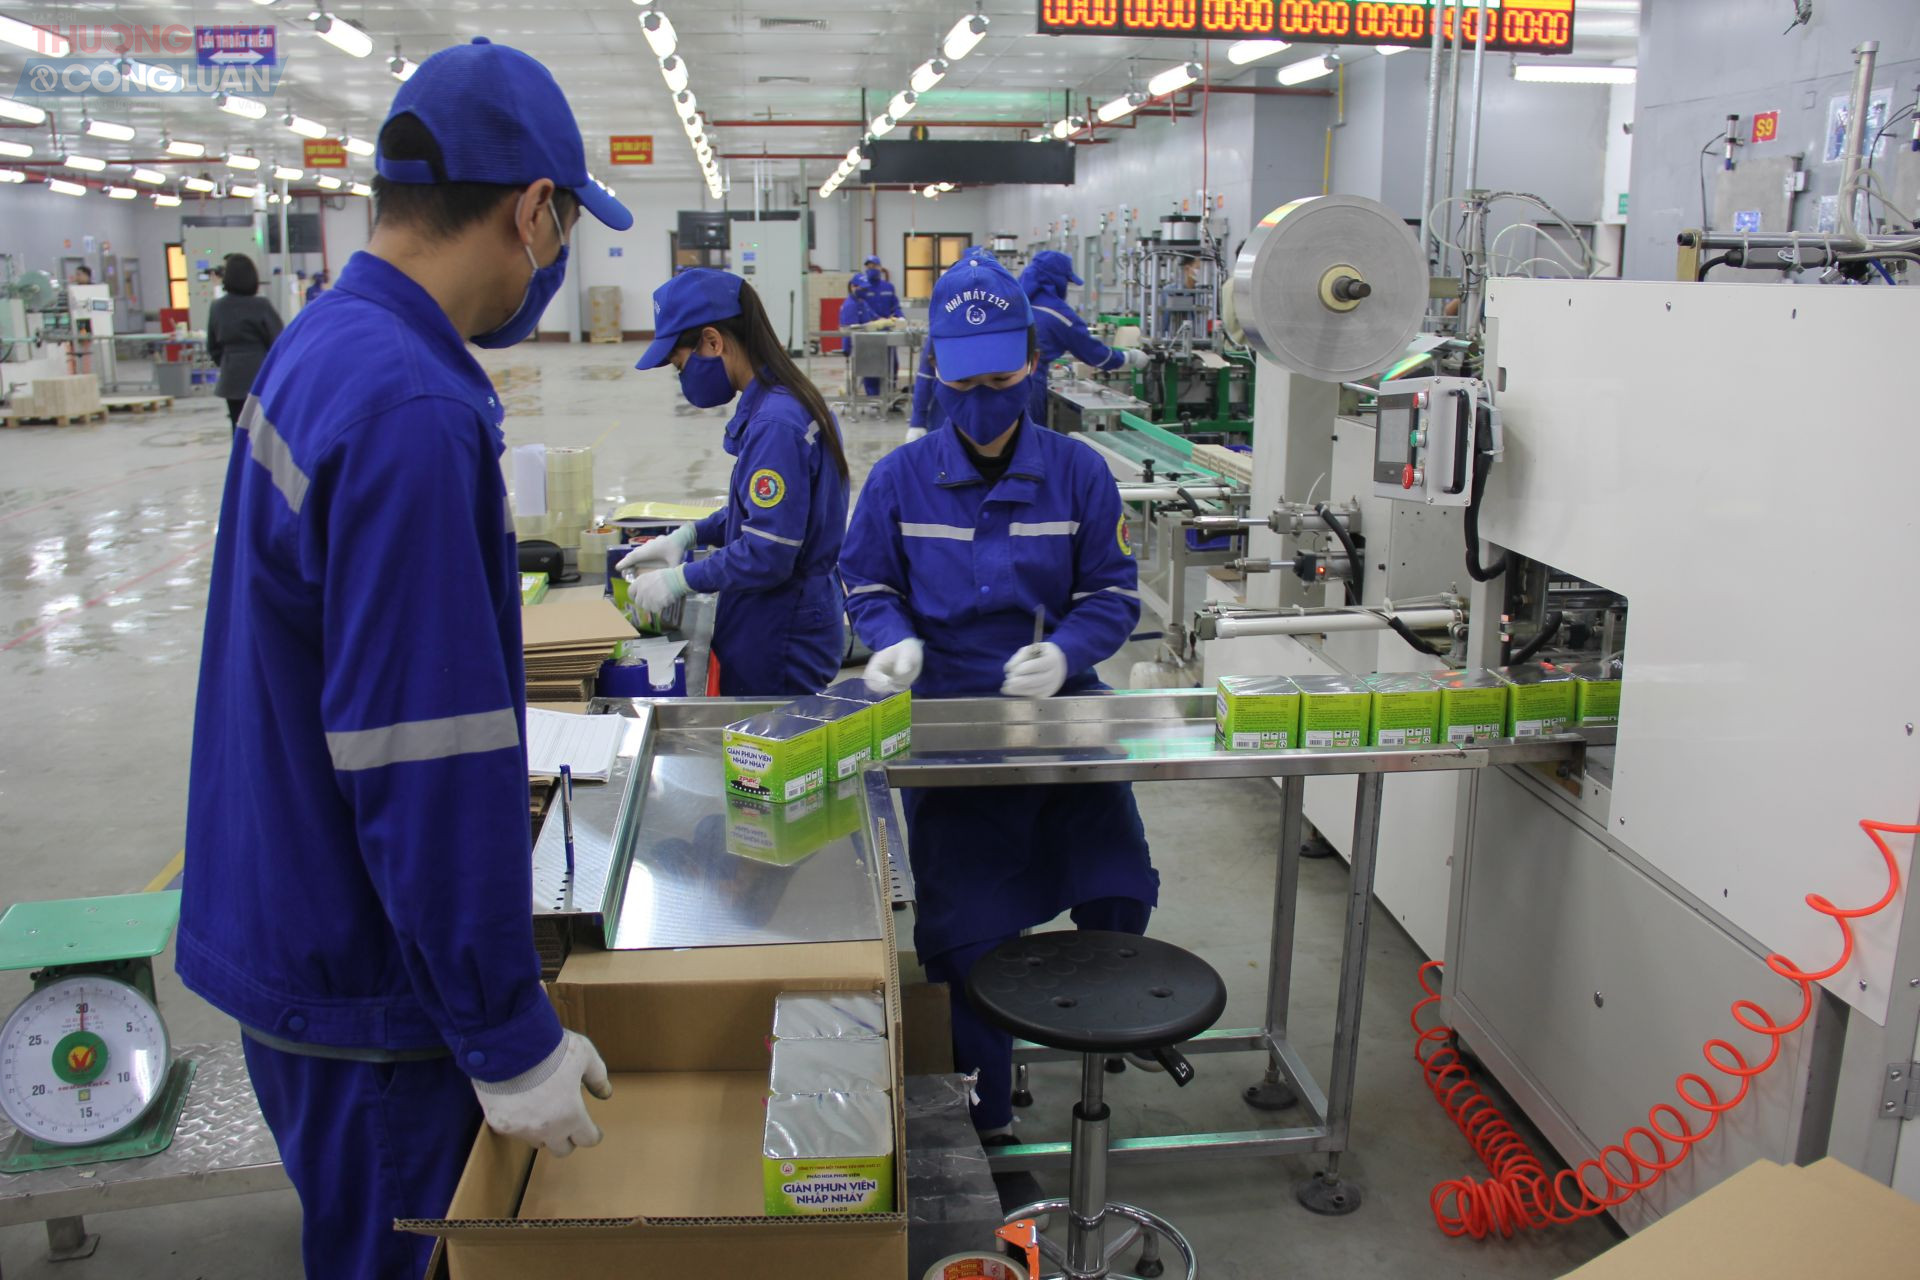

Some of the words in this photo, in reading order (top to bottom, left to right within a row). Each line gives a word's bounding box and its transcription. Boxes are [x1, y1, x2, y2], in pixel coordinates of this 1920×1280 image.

[1123, 0, 1196, 28] 00:00
[1202, 0, 1274, 31] 00:00
[1279, 1, 1348, 34] 00:00
[1355, 3, 1424, 37] 00:00
[1503, 10, 1569, 44] 00:00
[1756, 117, 1775, 137] S9
[945, 293, 963, 313] NHÀ
[963, 288, 987, 302] MÁY
[988, 293, 1010, 311] Z121
[75, 1002, 89, 1014] 30
[126, 1022, 133, 1032] 5
[28, 1034, 42, 1046] 25
[117, 1072, 130, 1083] 10
[32, 1084, 46, 1096] 20
[80, 1107, 93, 1118] 15
[783, 1182, 811, 1193] GIÀN
[814, 1183, 847, 1192] PHUN
[849, 1180, 876, 1190] VIÊN
